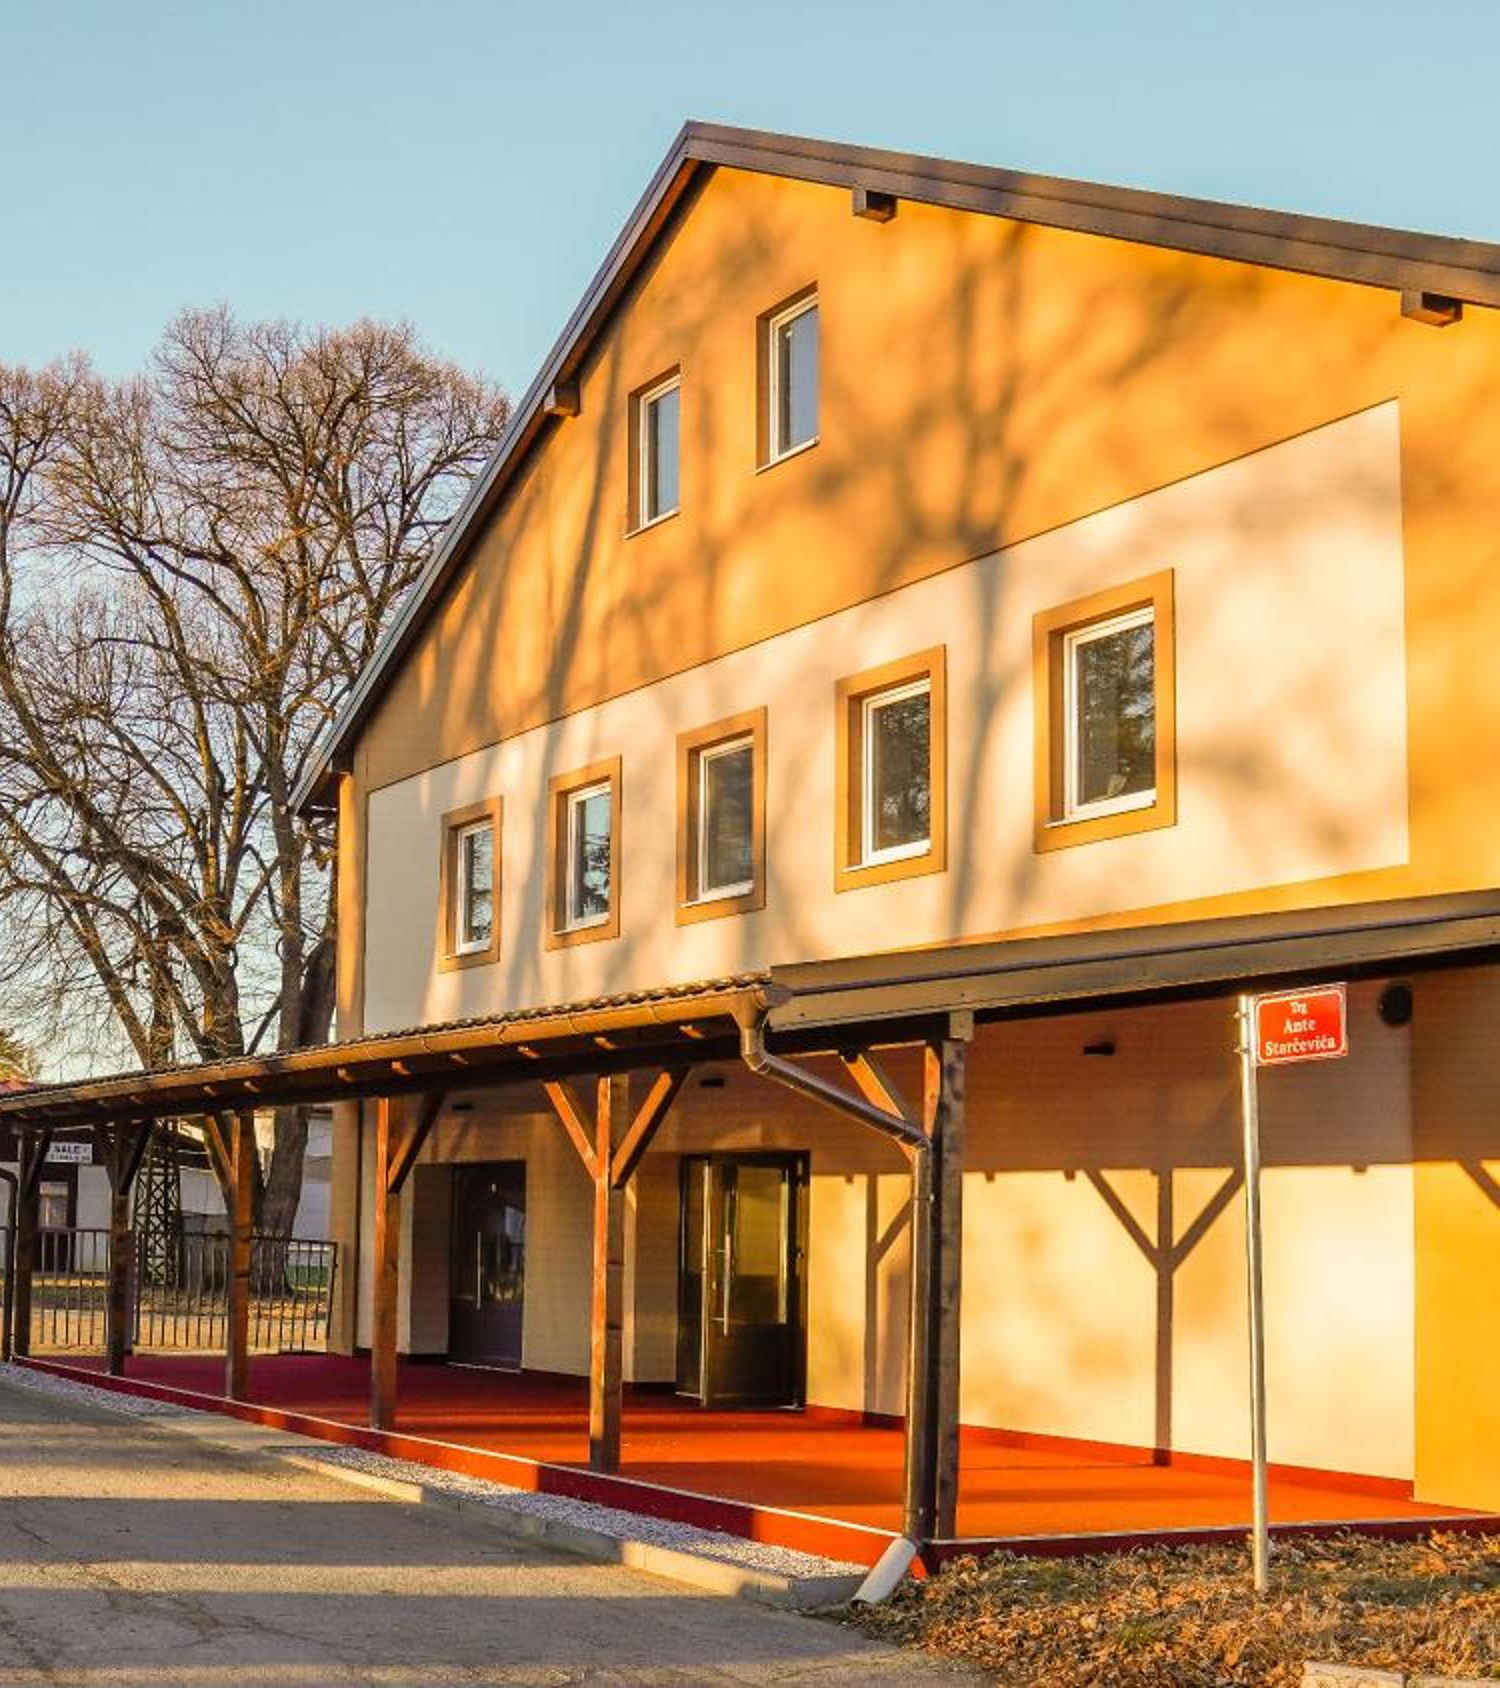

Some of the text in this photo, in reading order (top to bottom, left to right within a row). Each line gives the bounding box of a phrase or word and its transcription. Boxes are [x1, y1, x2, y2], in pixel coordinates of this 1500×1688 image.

[1290, 1001, 1308, 1015] Trg
[1284, 1019, 1316, 1034] Ante
[1265, 1034, 1336, 1056] Starčevića
